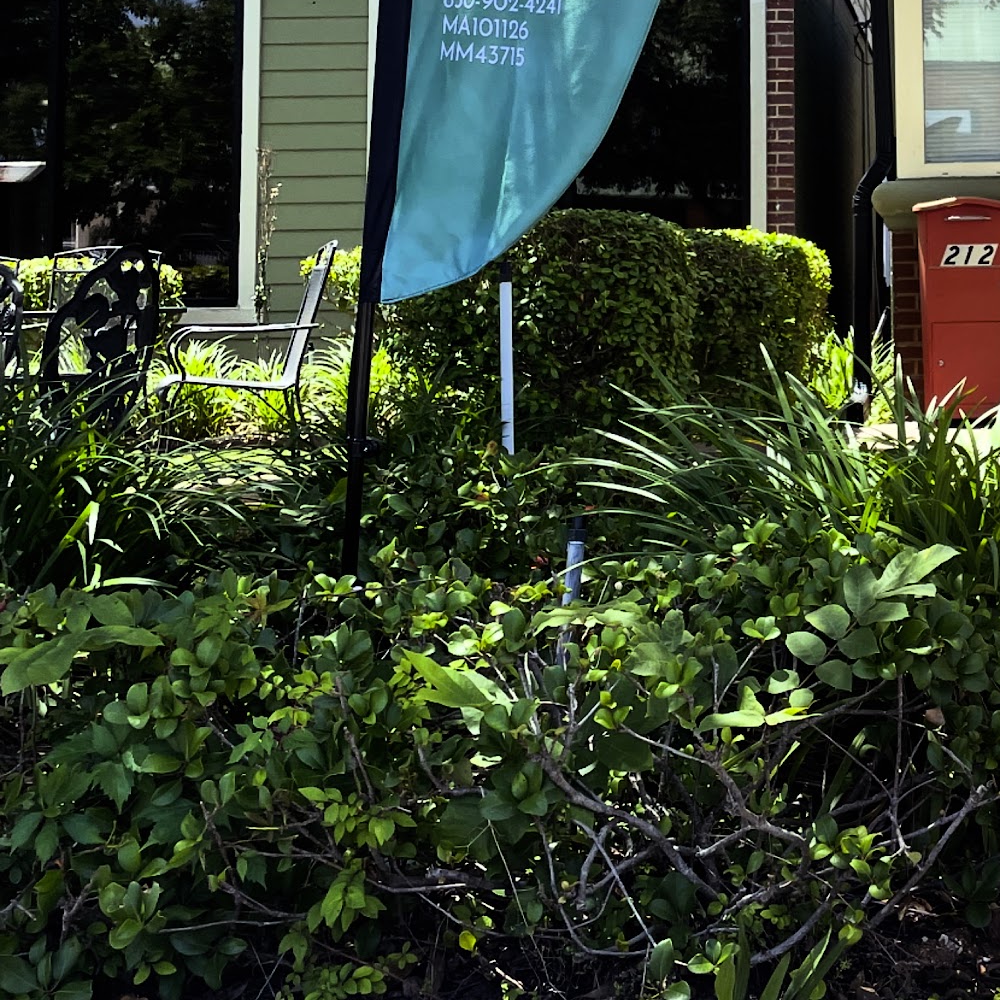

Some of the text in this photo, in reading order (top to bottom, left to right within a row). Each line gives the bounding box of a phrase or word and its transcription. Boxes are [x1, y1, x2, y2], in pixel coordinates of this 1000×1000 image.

[442, 14, 529, 40] MA101126
[440, 40, 526, 66] MM43715
[943, 245, 994, 265] 212
